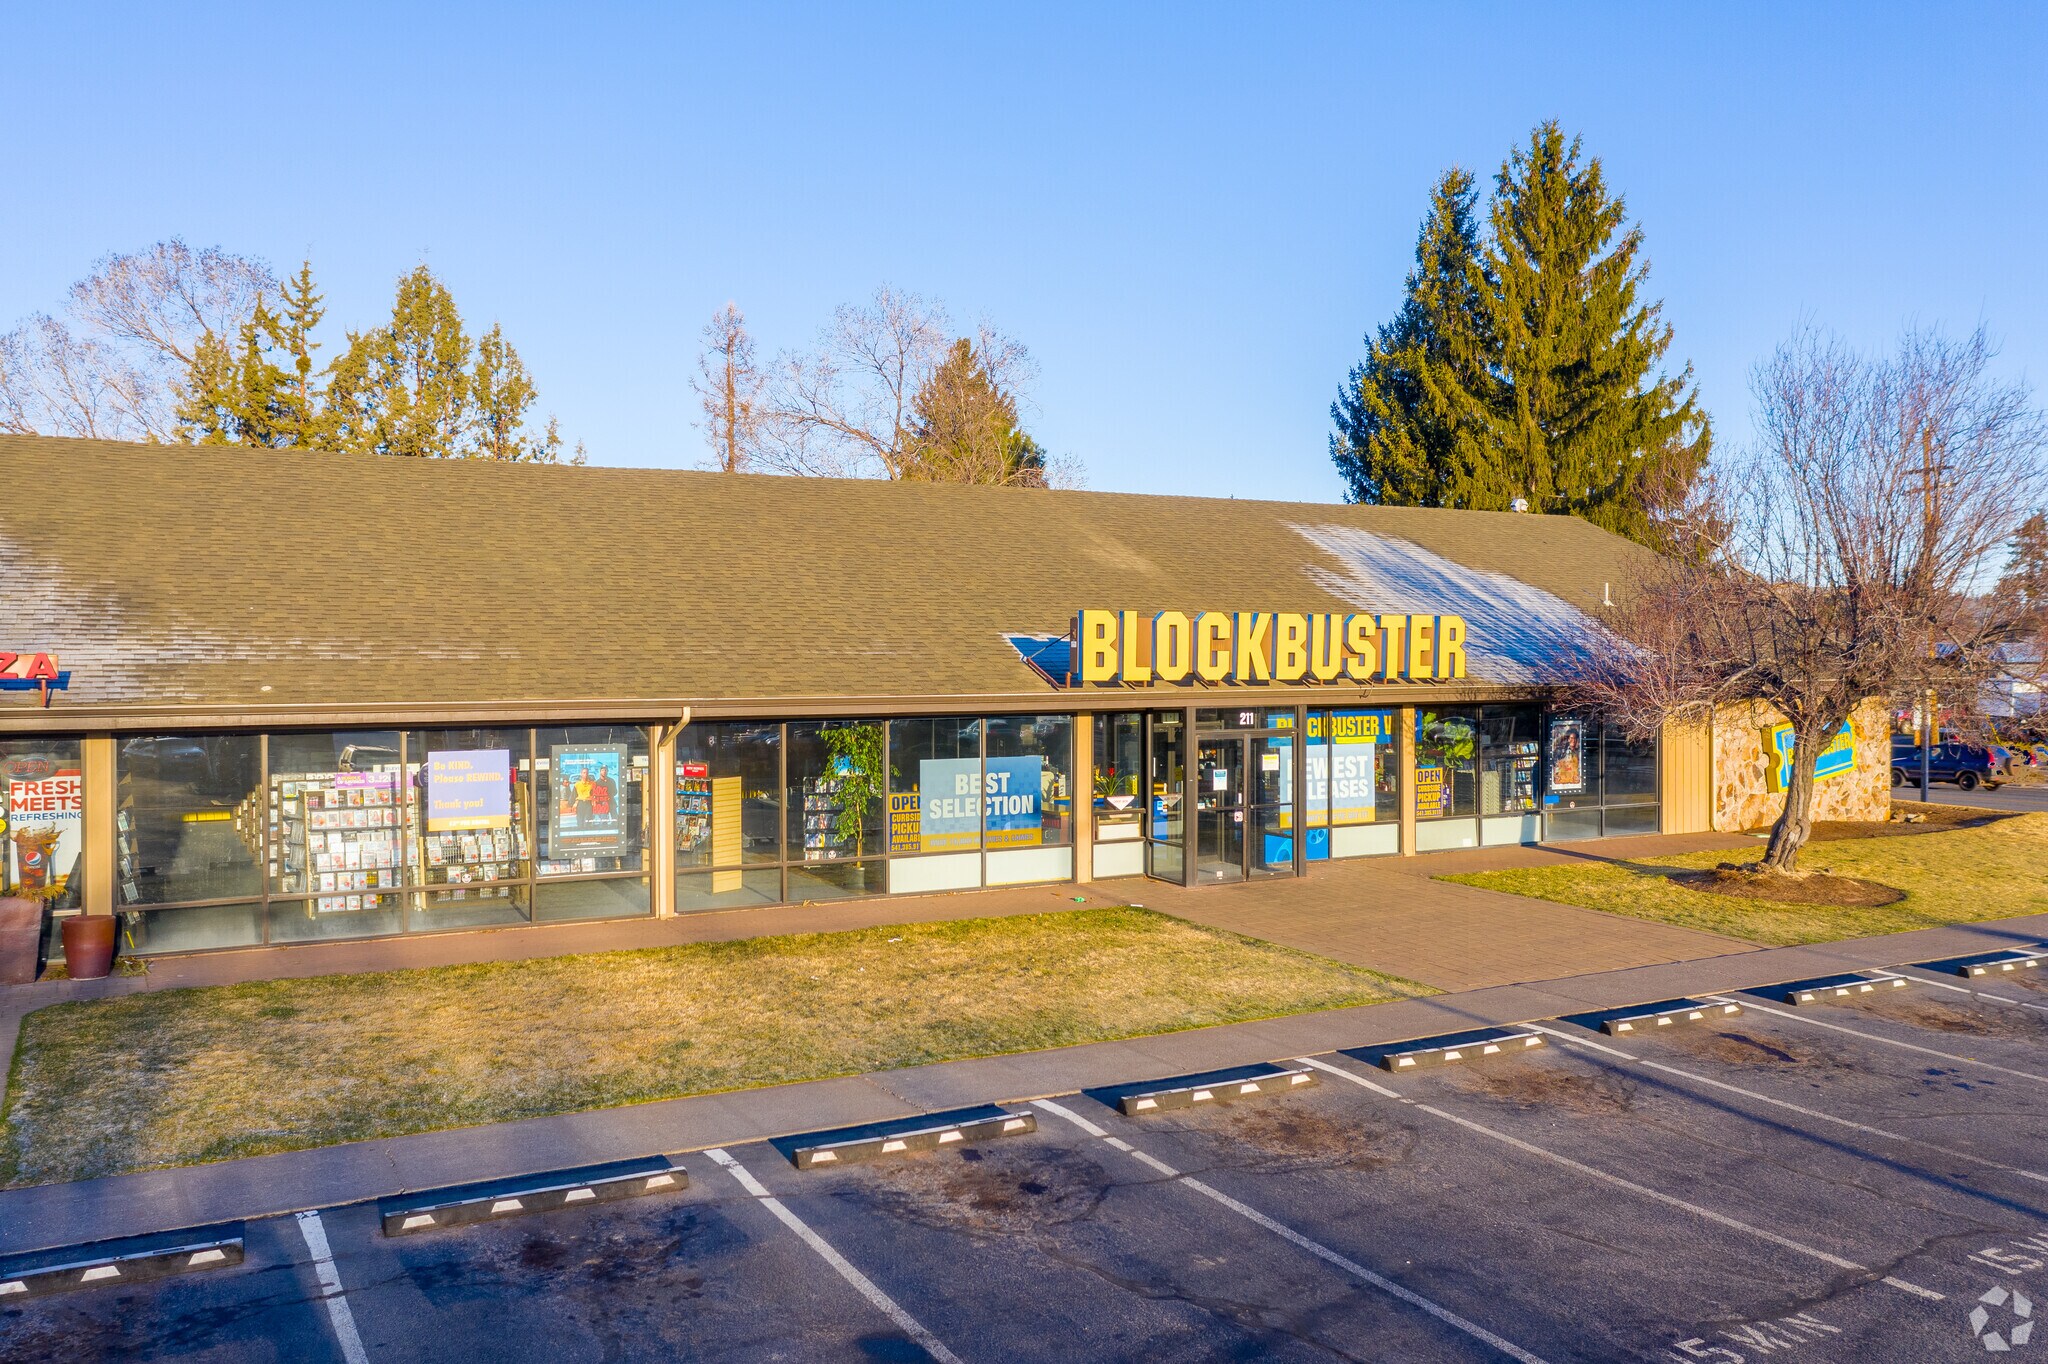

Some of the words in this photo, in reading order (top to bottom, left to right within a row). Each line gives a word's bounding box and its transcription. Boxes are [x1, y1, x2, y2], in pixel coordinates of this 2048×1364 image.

[1079, 610, 1467, 682] BLOCKBUSTER
[0, 652, 58, 679] ZA
[1240, 712, 1254, 725] 211
[2, 760, 49, 774] OPEN
[434, 761, 446, 770] Be
[448, 761, 474, 770] KIND.
[434, 774, 464, 784] Please
[466, 772, 504, 782] REWIND.
[955, 772, 1010, 795] BEST
[1417, 770, 1441, 783] OPEN
[10, 781, 82, 796] FRESH
[10, 796, 82, 813] MEETS
[434, 799, 462, 809] Thank
[464, 798, 484, 811] you!
[1417, 792, 1442, 802] PICKUP
[929, 795, 1034, 819] SELECTION
[1965, 1246, 2044, 1275] 15
[1715, 1312, 1843, 1355] MIN
